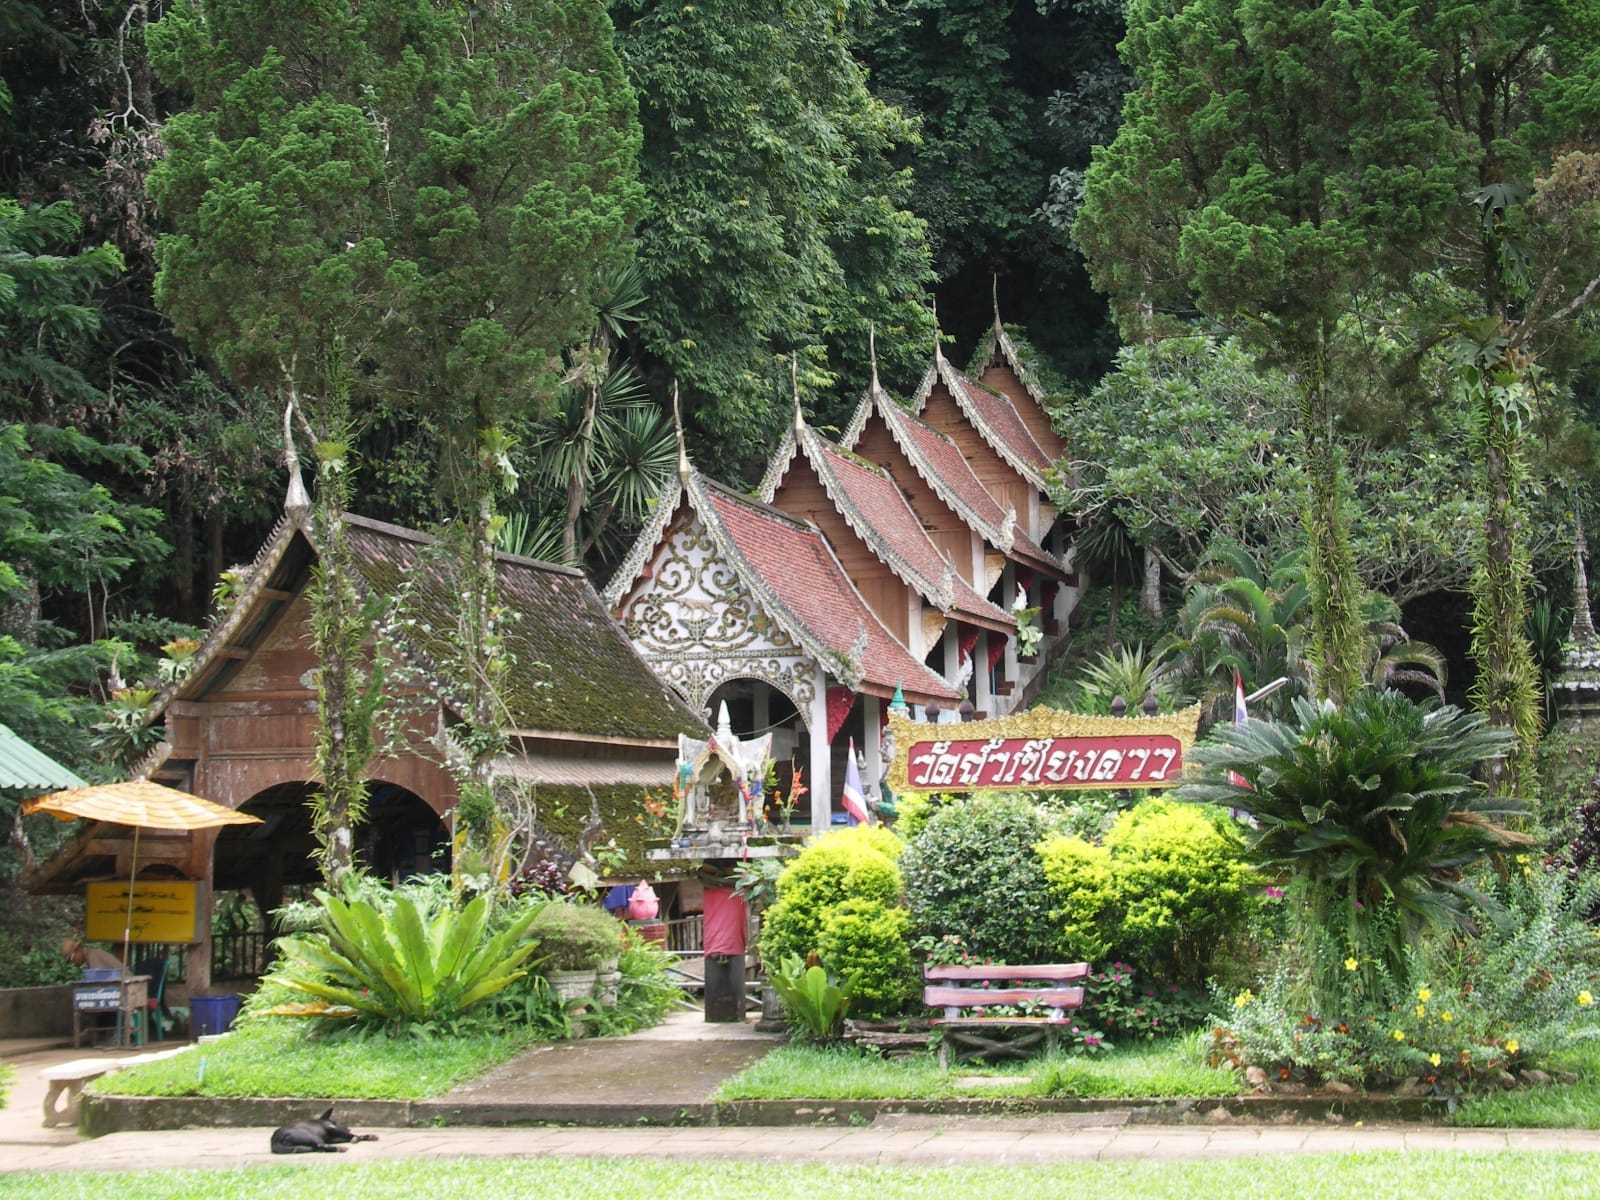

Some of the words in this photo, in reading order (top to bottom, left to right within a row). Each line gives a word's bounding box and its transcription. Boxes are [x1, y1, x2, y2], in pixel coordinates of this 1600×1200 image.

[912, 738, 1176, 785] วัดถ้ำเชียงดาว
